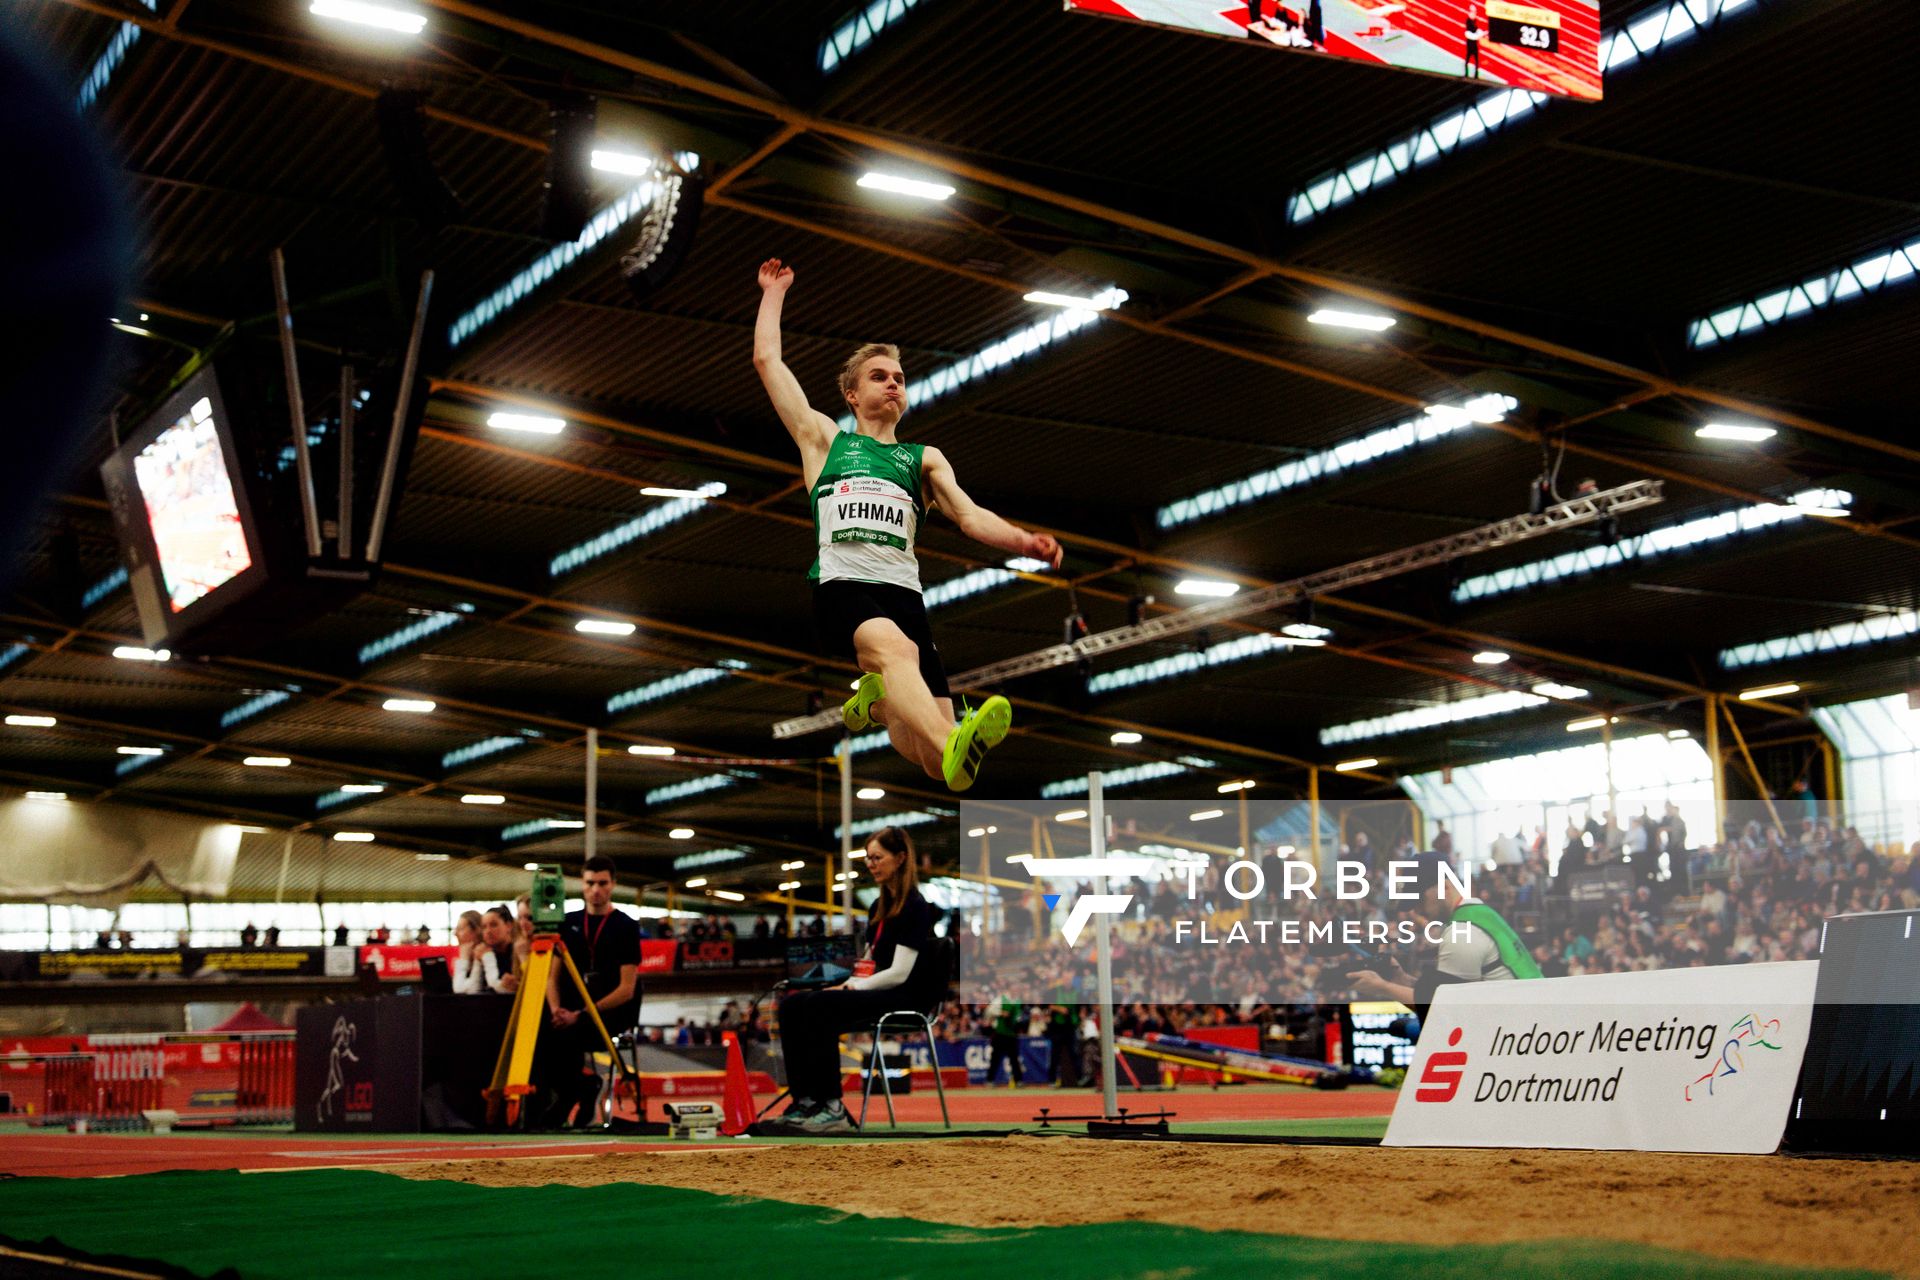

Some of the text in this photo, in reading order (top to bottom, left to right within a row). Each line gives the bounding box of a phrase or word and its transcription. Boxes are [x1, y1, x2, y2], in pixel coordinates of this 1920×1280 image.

[1520, 25, 1550, 49] 32.9
[838, 502, 903, 528] VEHMAA
[838, 530, 888, 542] DORTMUND 26
[1489, 1017, 1718, 1060] Indoor Meeting
[1474, 1067, 1624, 1103] Dortmund
